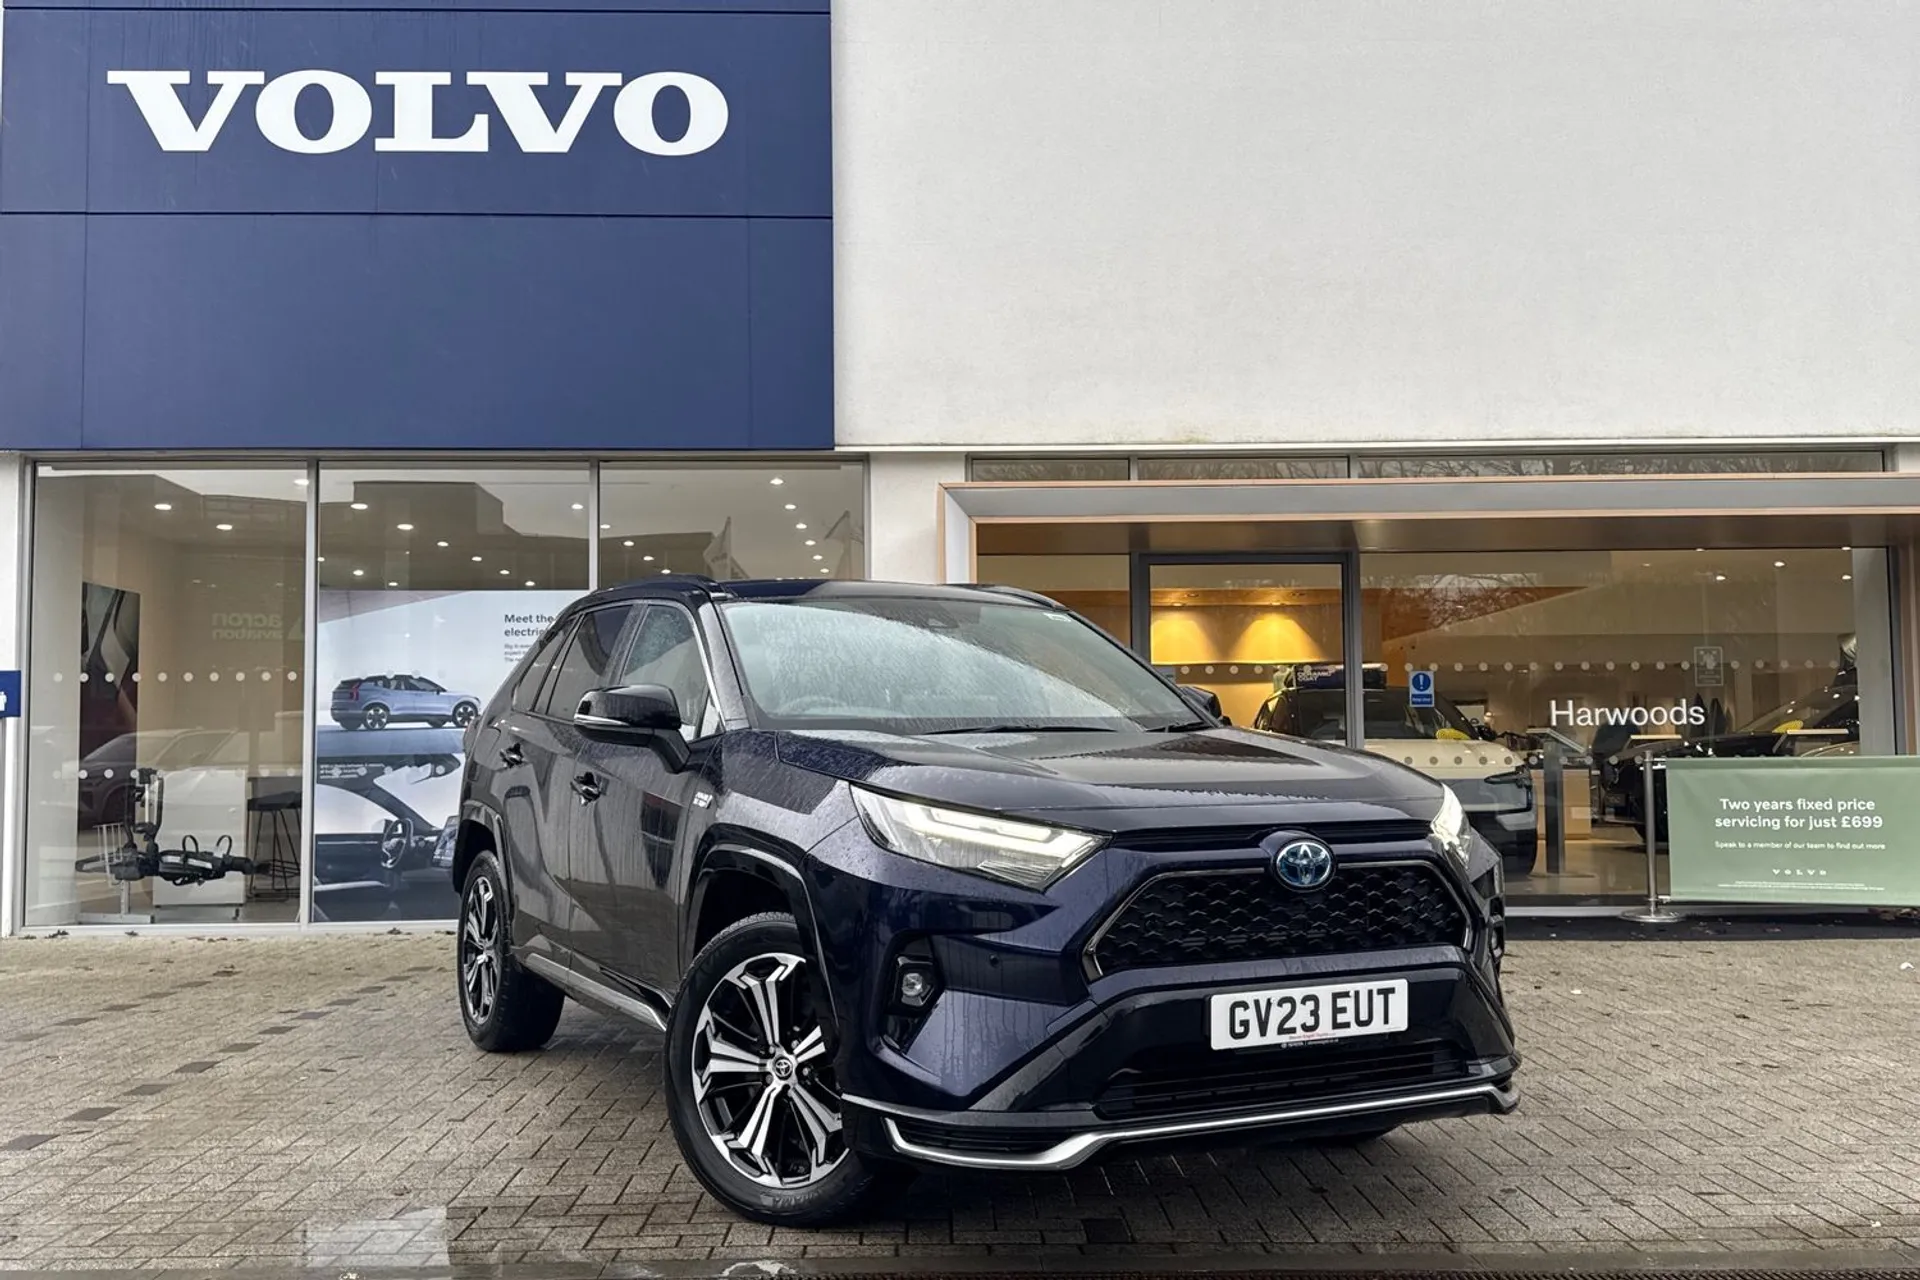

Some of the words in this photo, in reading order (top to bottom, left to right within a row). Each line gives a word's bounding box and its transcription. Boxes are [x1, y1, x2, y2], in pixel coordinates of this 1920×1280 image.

[107, 69, 729, 156] VOLVO
[504, 614, 533, 623] Meet
[536, 613, 555, 623] the
[1550, 698, 1705, 726] Harwoods
[1719, 798, 1750, 811] Two
[1753, 800, 1793, 813] years
[1797, 798, 1833, 811] fixed
[1837, 798, 1876, 813] price
[1715, 815, 1781, 830] servicing
[1784, 815, 1806, 828] for
[1808, 815, 1838, 831] just
[1841, 815, 1883, 828] £699
[1714, 840, 1737, 849] Speak
[1753, 841, 1783, 849] member
[1806, 841, 1826, 849] team
[1835, 841, 1851, 849] find
[1772, 868, 1827, 876] VOLVO
[1229, 993, 1320, 1040] GV23
[1331, 987, 1396, 1030] EUT
